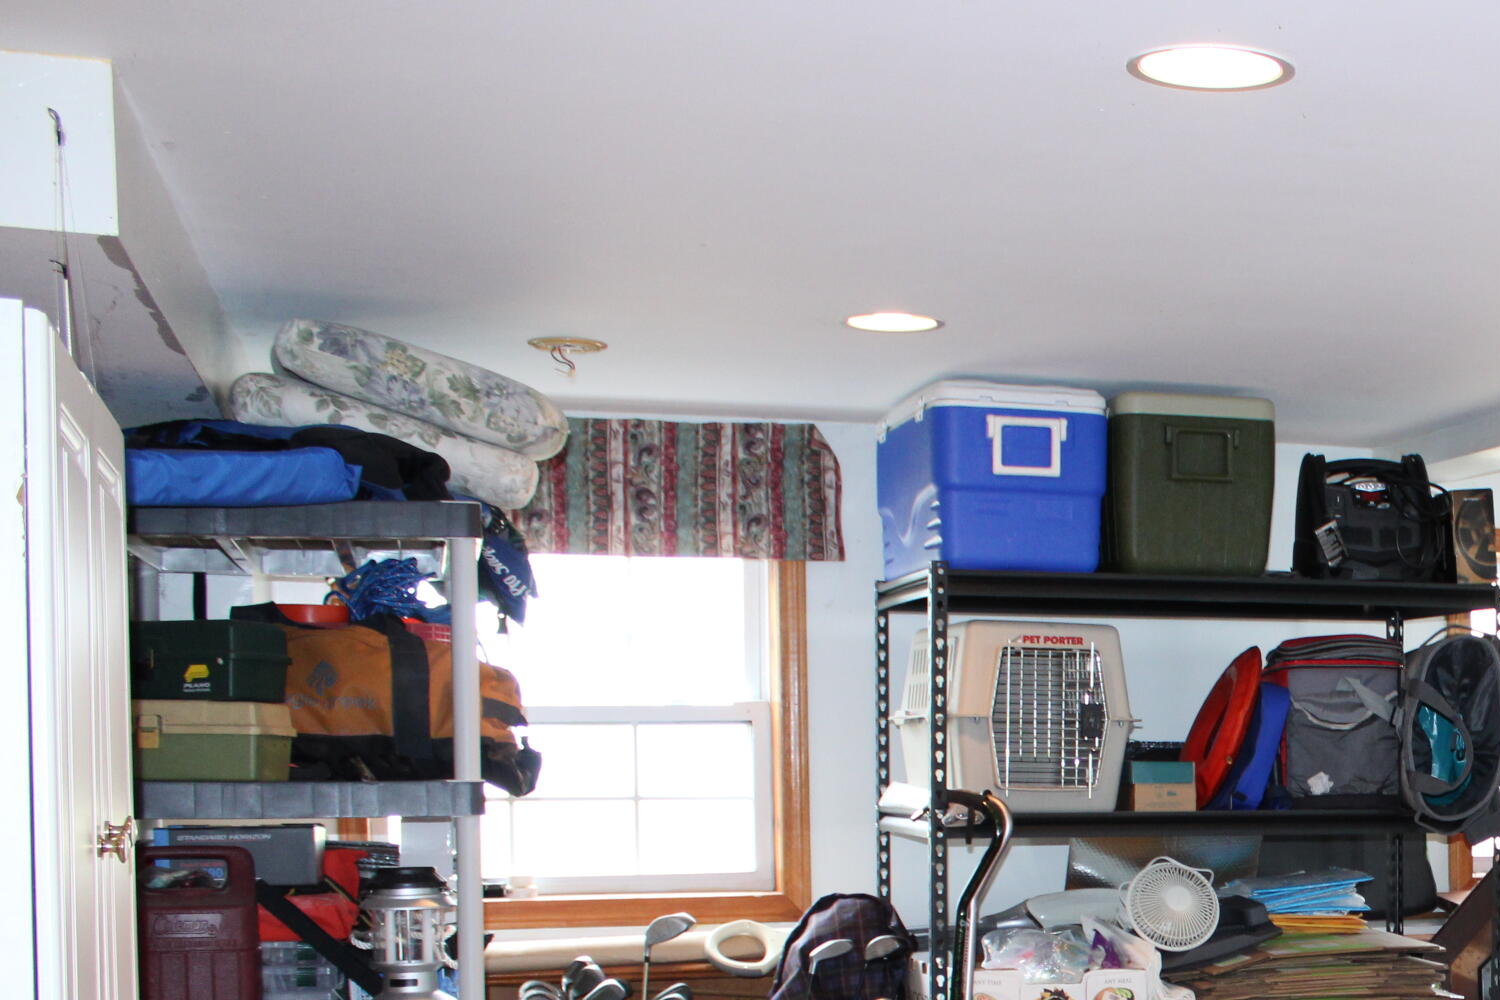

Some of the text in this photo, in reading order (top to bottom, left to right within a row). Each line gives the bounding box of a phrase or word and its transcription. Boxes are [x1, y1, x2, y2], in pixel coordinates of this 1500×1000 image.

[1023, 634, 1084, 646] PET PORTER
[229, 833, 271, 841] HORIZON
